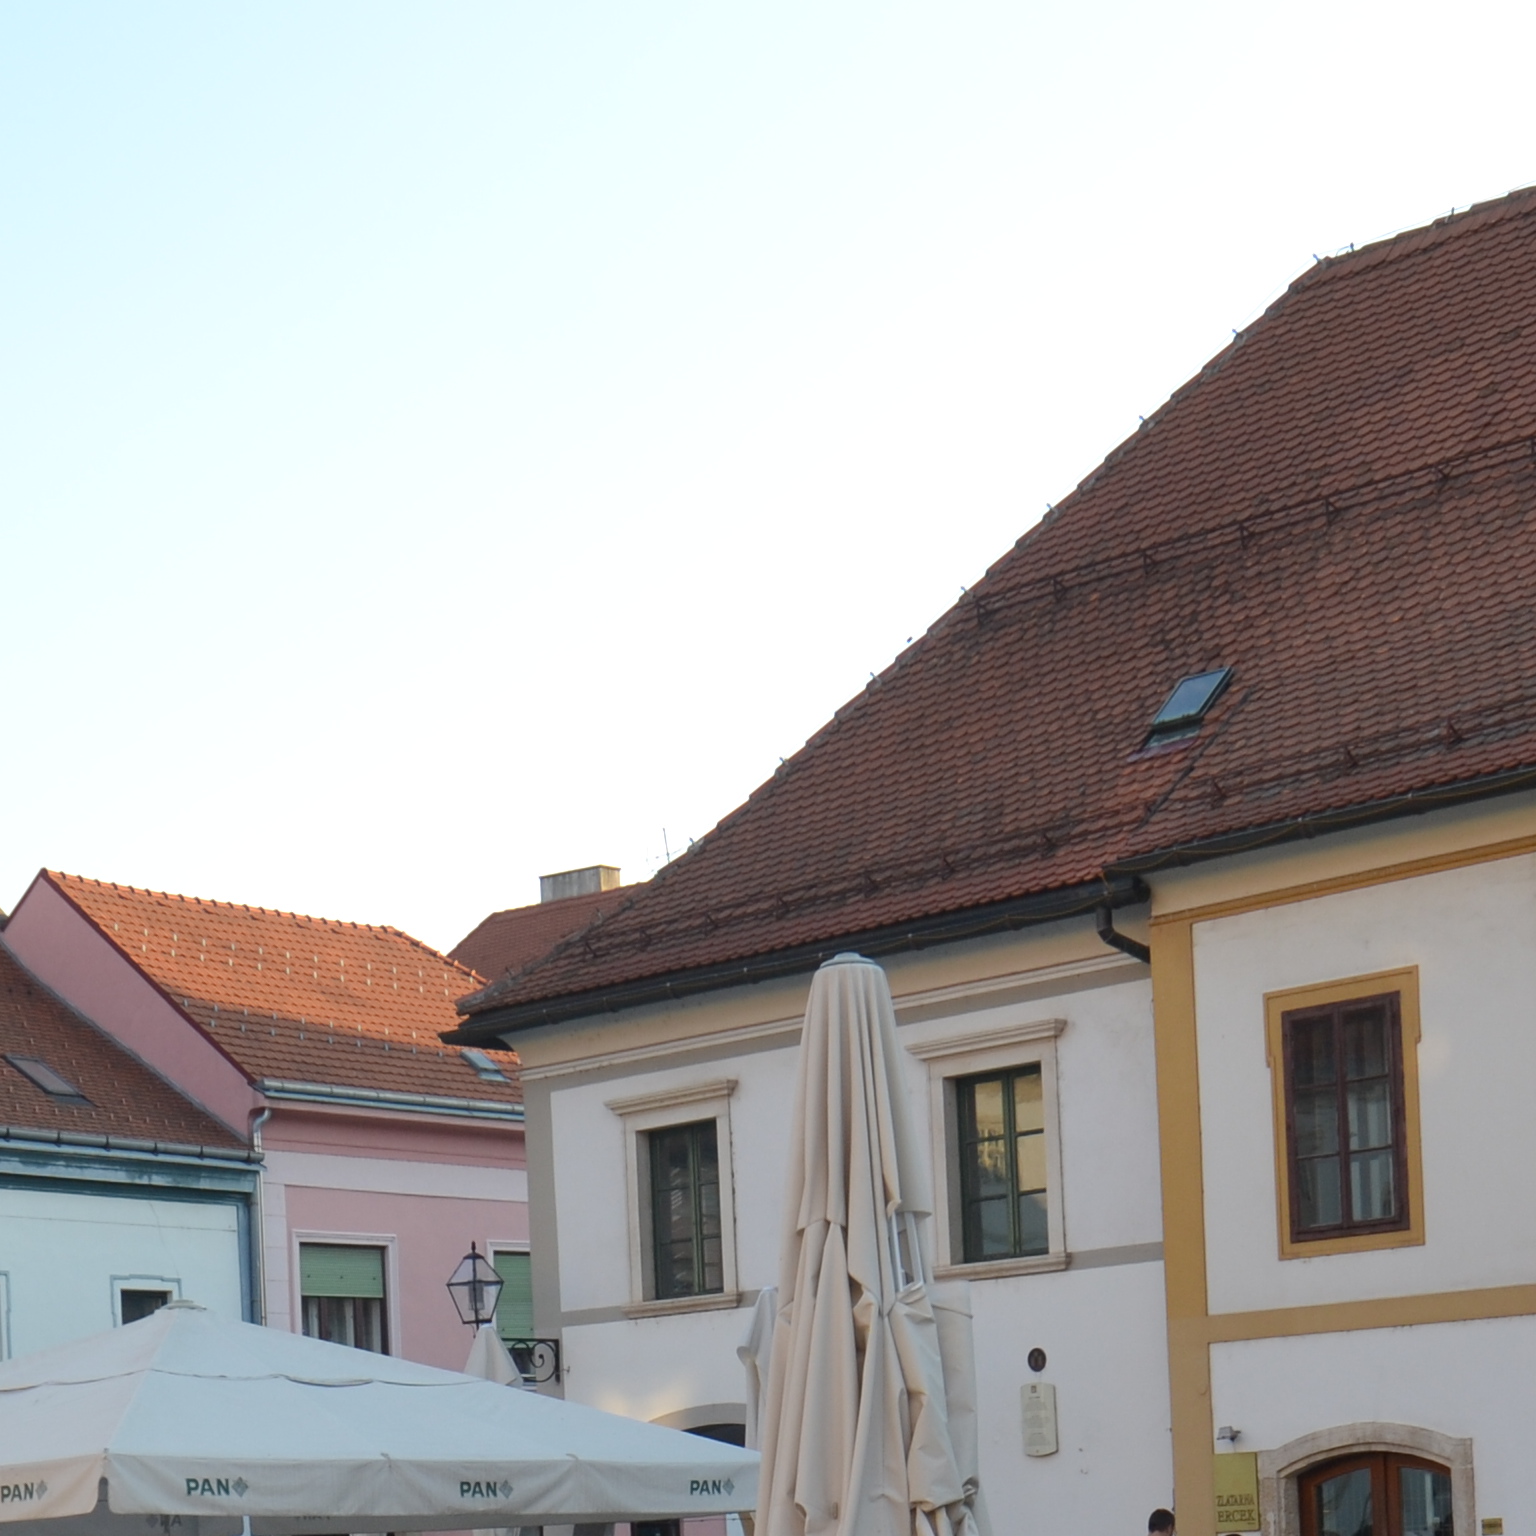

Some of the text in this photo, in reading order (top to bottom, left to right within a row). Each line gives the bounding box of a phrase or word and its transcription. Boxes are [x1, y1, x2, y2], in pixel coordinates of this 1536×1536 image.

[0, 1482, 34, 1504] PAN
[186, 1478, 230, 1497] PAN
[459, 1481, 498, 1498] PAN
[690, 1479, 722, 1495] PAN
